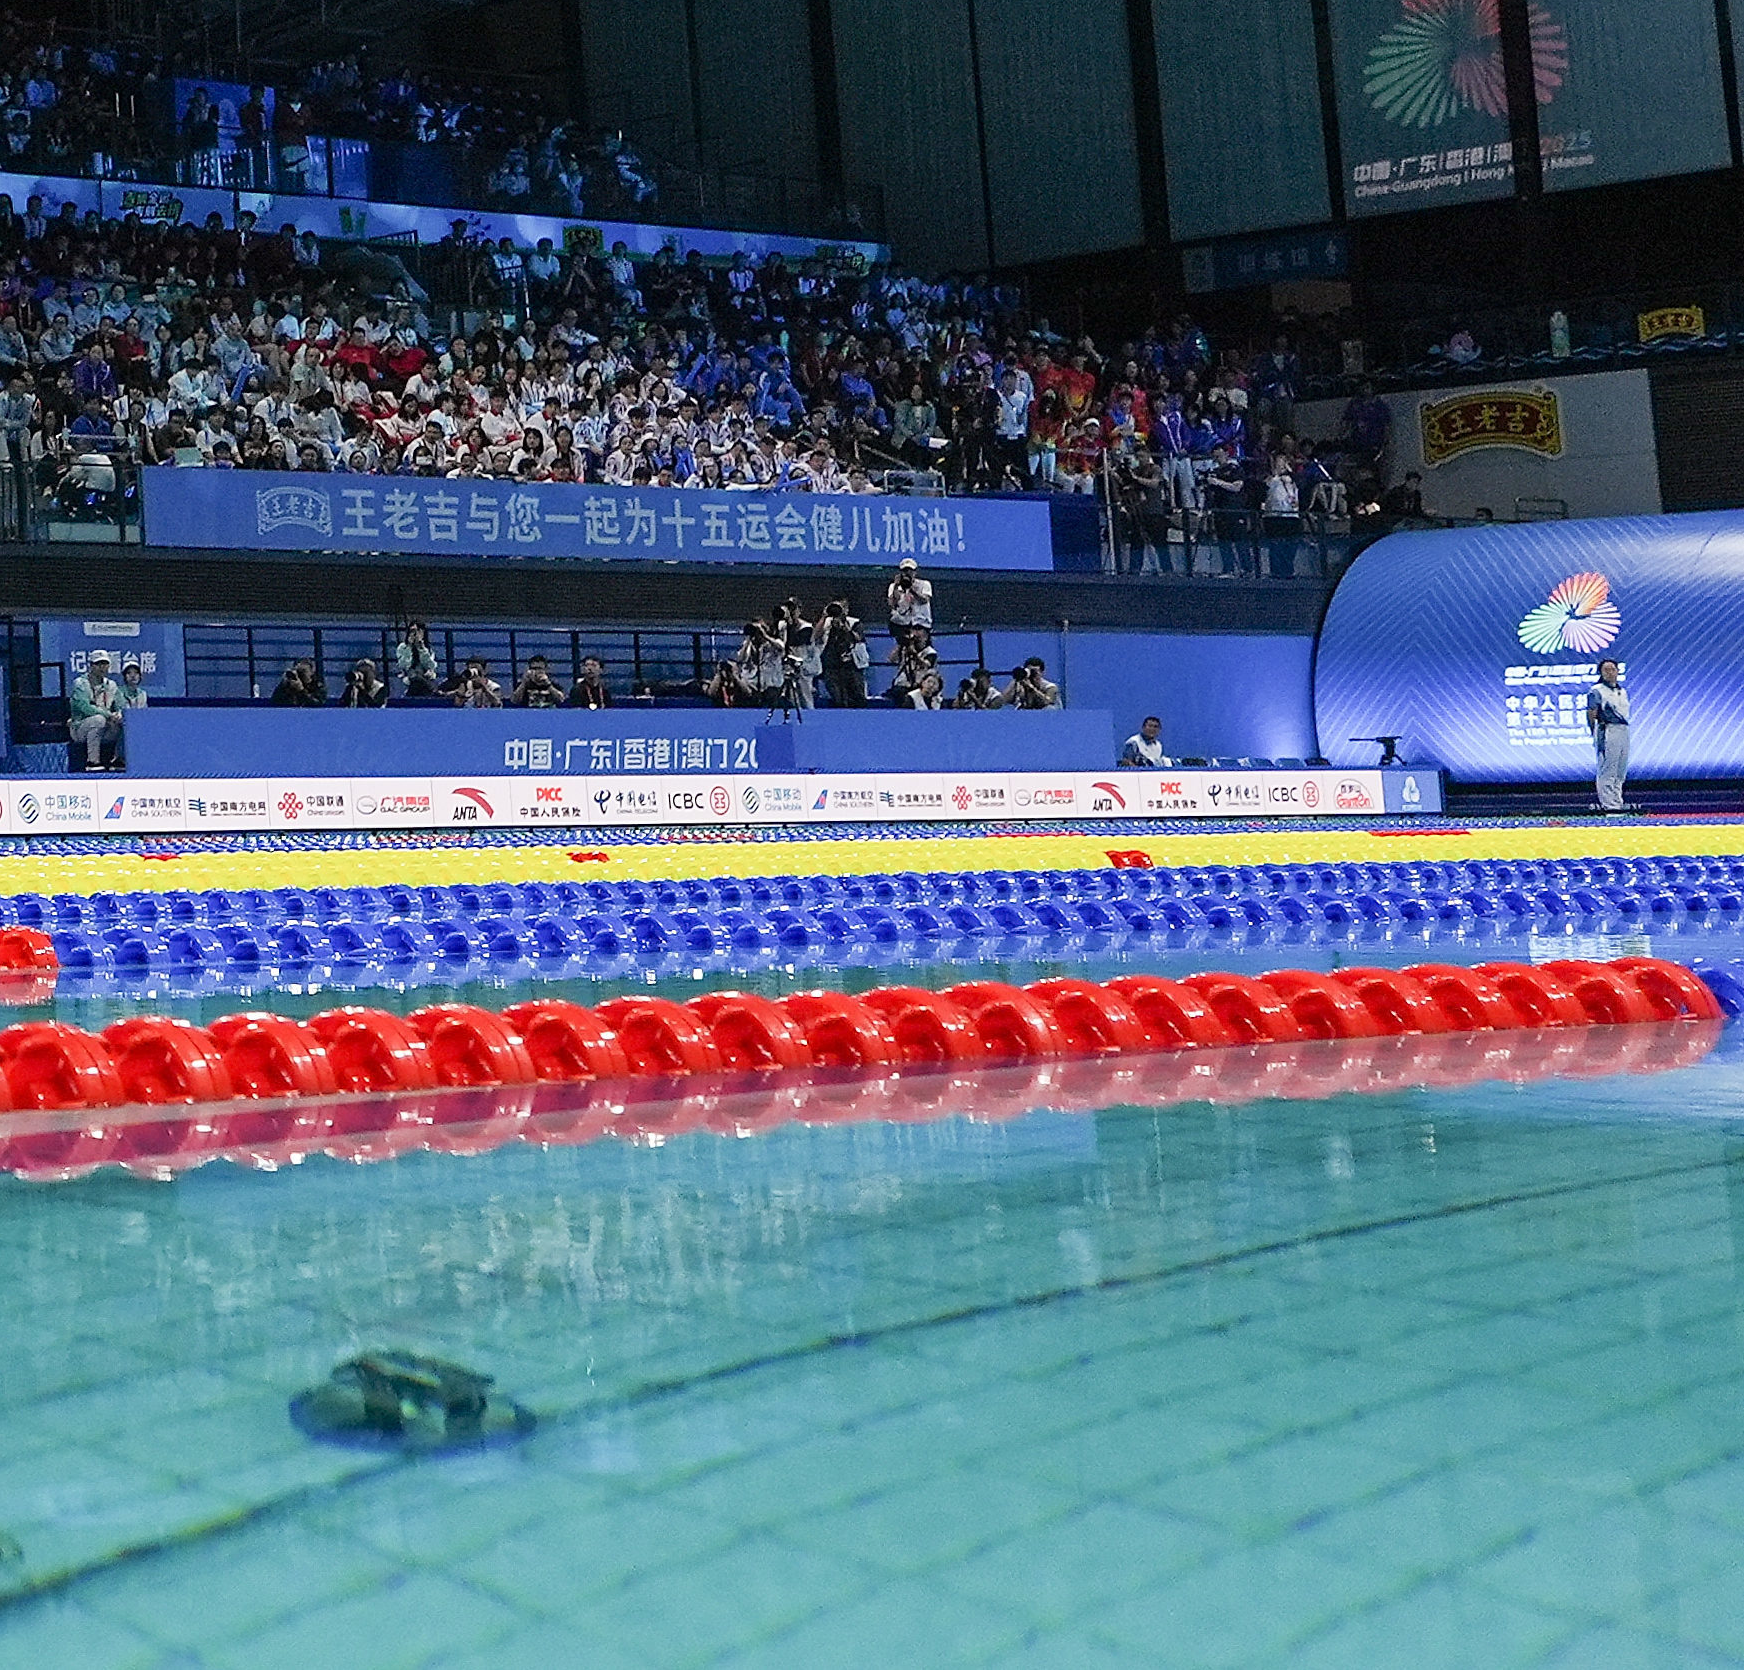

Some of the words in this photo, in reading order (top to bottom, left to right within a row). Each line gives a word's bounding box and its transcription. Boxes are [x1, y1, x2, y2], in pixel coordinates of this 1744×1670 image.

[1449, 403, 1530, 438] 王老吉
[536, 787, 562, 802] PICC
[1161, 782, 1182, 795] PICC
[1268, 787, 1298, 802] ICBC
[668, 793, 704, 809] ICBC
[1092, 800, 1113, 811] ANTA
[452, 806, 478, 820] ANTA
